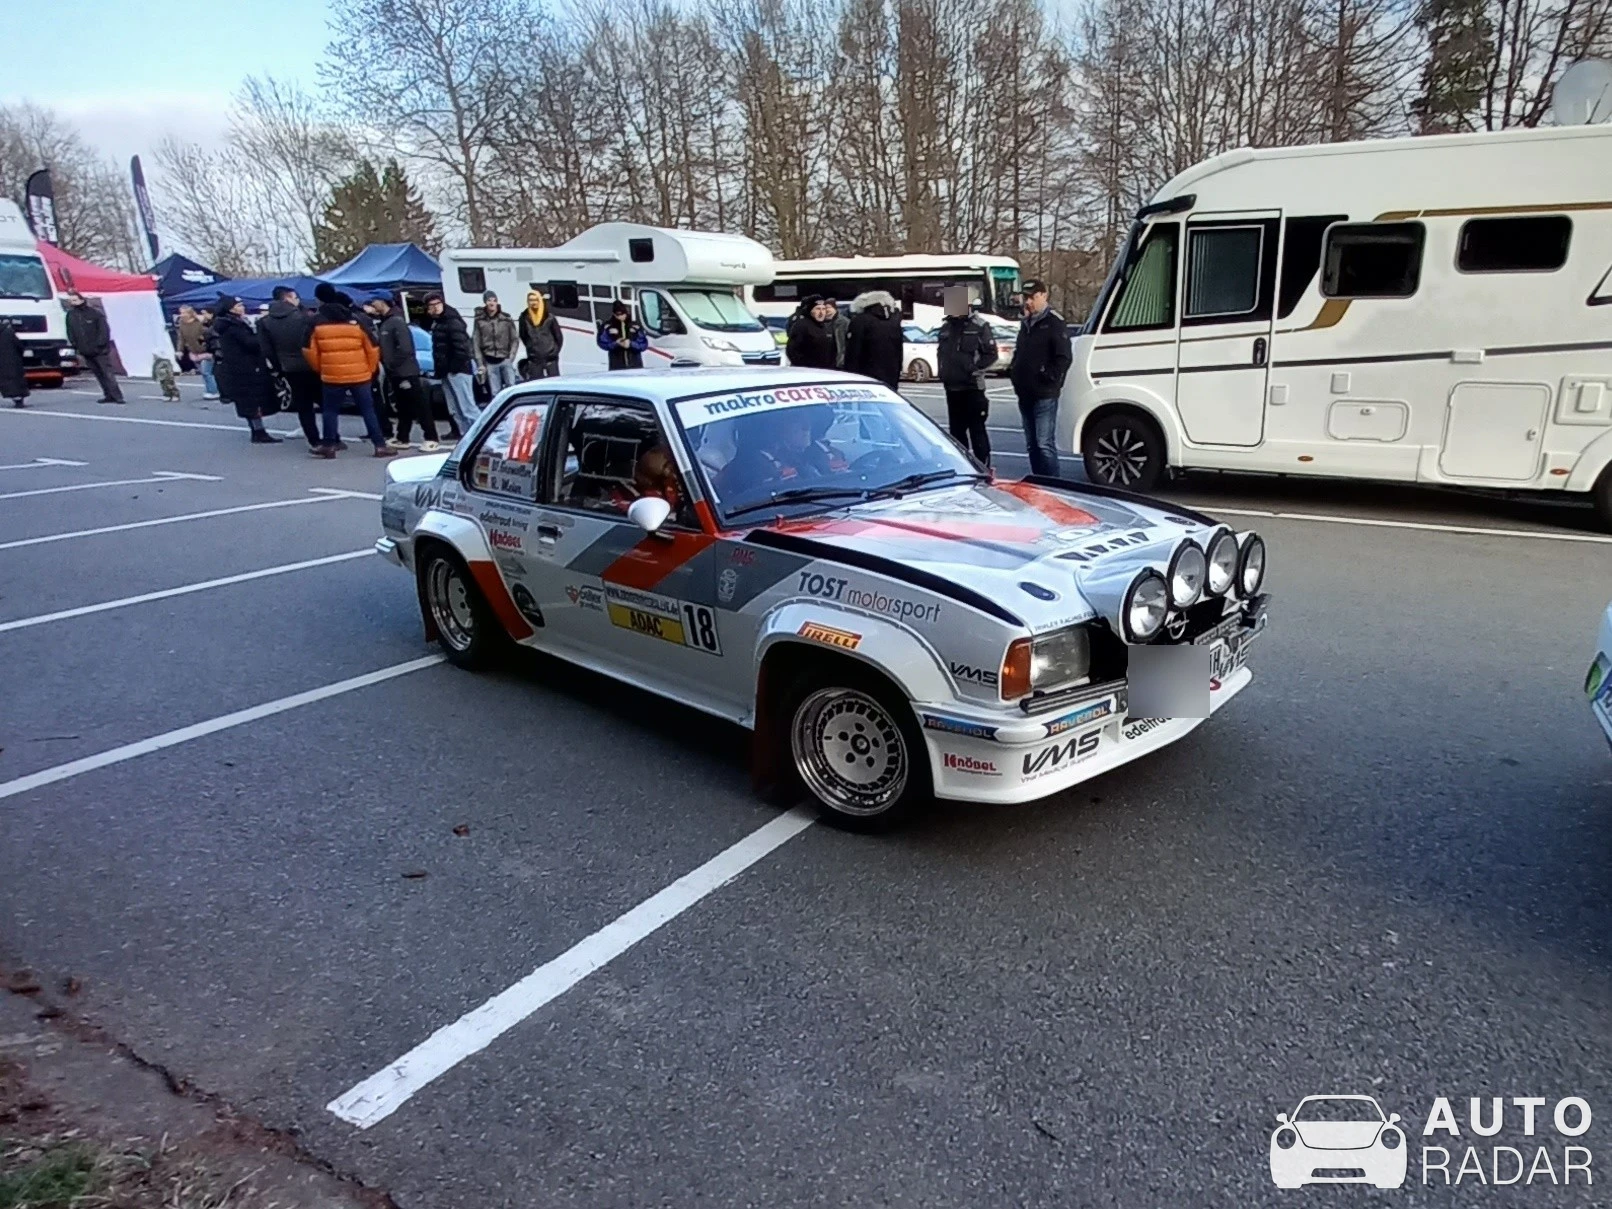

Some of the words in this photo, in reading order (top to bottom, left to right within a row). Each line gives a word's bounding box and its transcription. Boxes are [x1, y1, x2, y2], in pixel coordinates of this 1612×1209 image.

[799, 571, 848, 600] TOST
[848, 589, 941, 622] motorsport
[630, 611, 664, 637] ADAC
[684, 605, 717, 651] 18
[797, 621, 862, 650] PIRELLI
[951, 661, 998, 684] VMS
[1022, 728, 1101, 776] VMS
